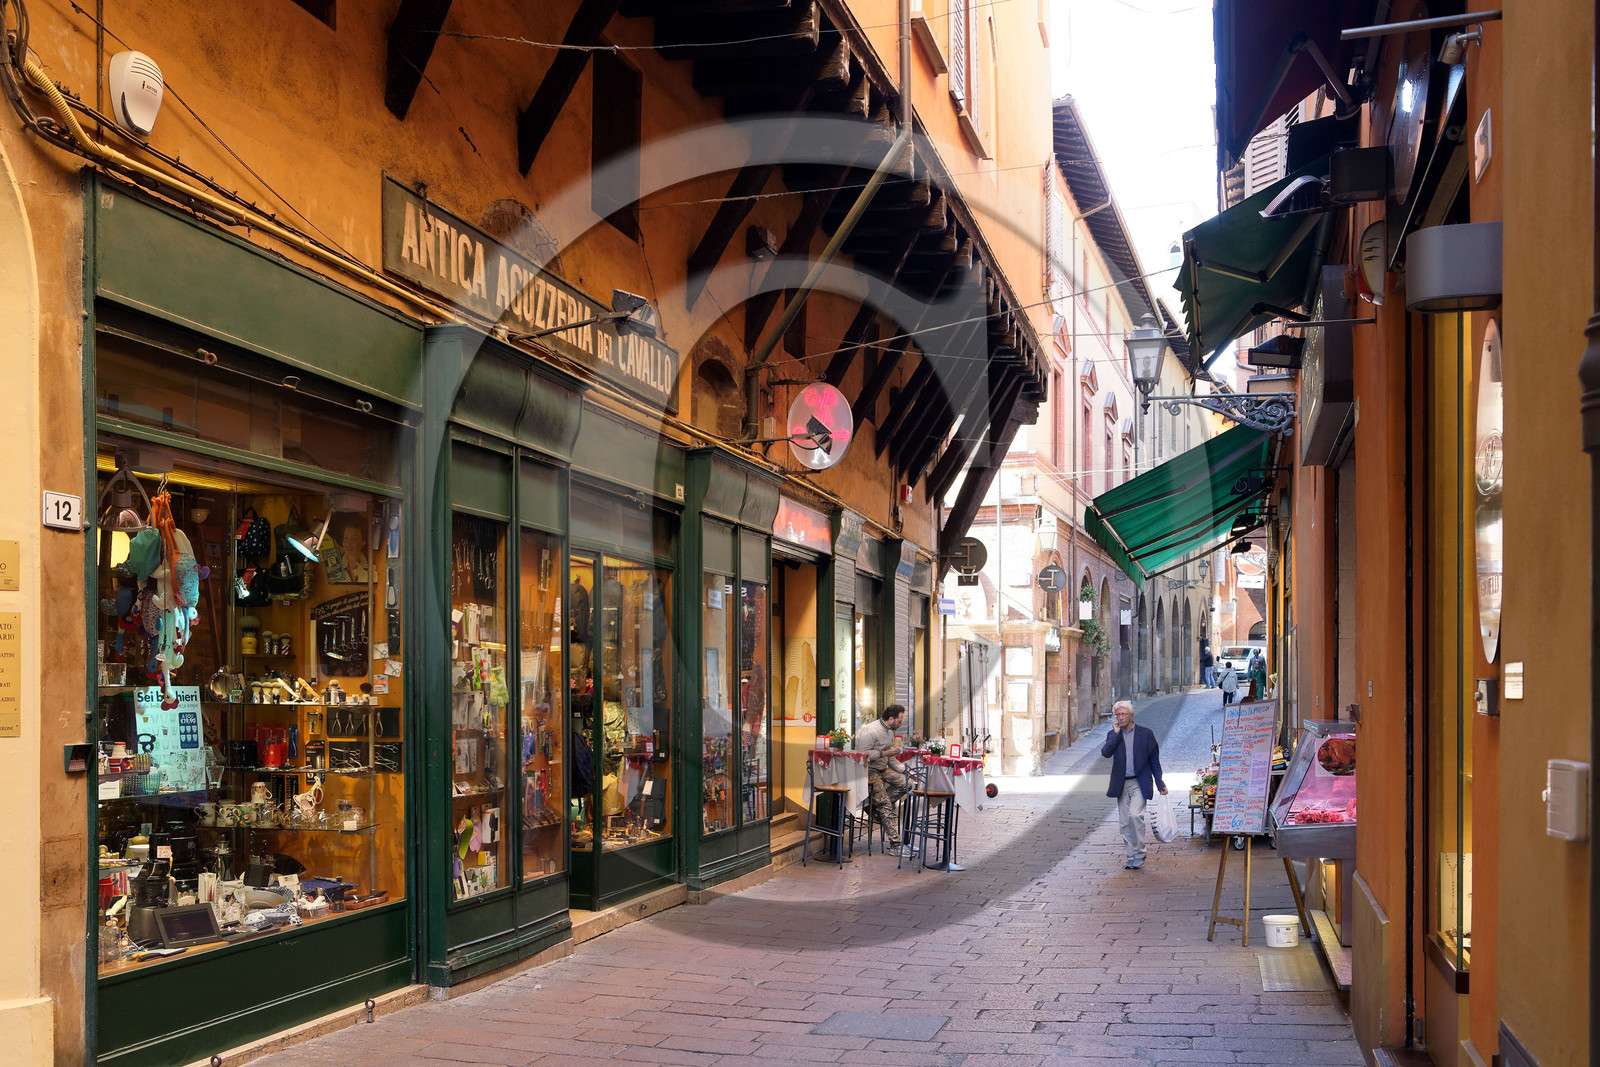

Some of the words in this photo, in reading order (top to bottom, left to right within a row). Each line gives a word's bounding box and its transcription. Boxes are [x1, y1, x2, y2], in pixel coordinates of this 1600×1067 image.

[401, 200, 488, 301] ANTICA
[495, 254, 594, 356] AGUZZERIA
[597, 328, 614, 366] DEL
[617, 334, 672, 395] CAVALLO
[54, 500, 72, 521] 12
[137, 690, 153, 702] Sei
[157, 690, 198, 702] bhieri
